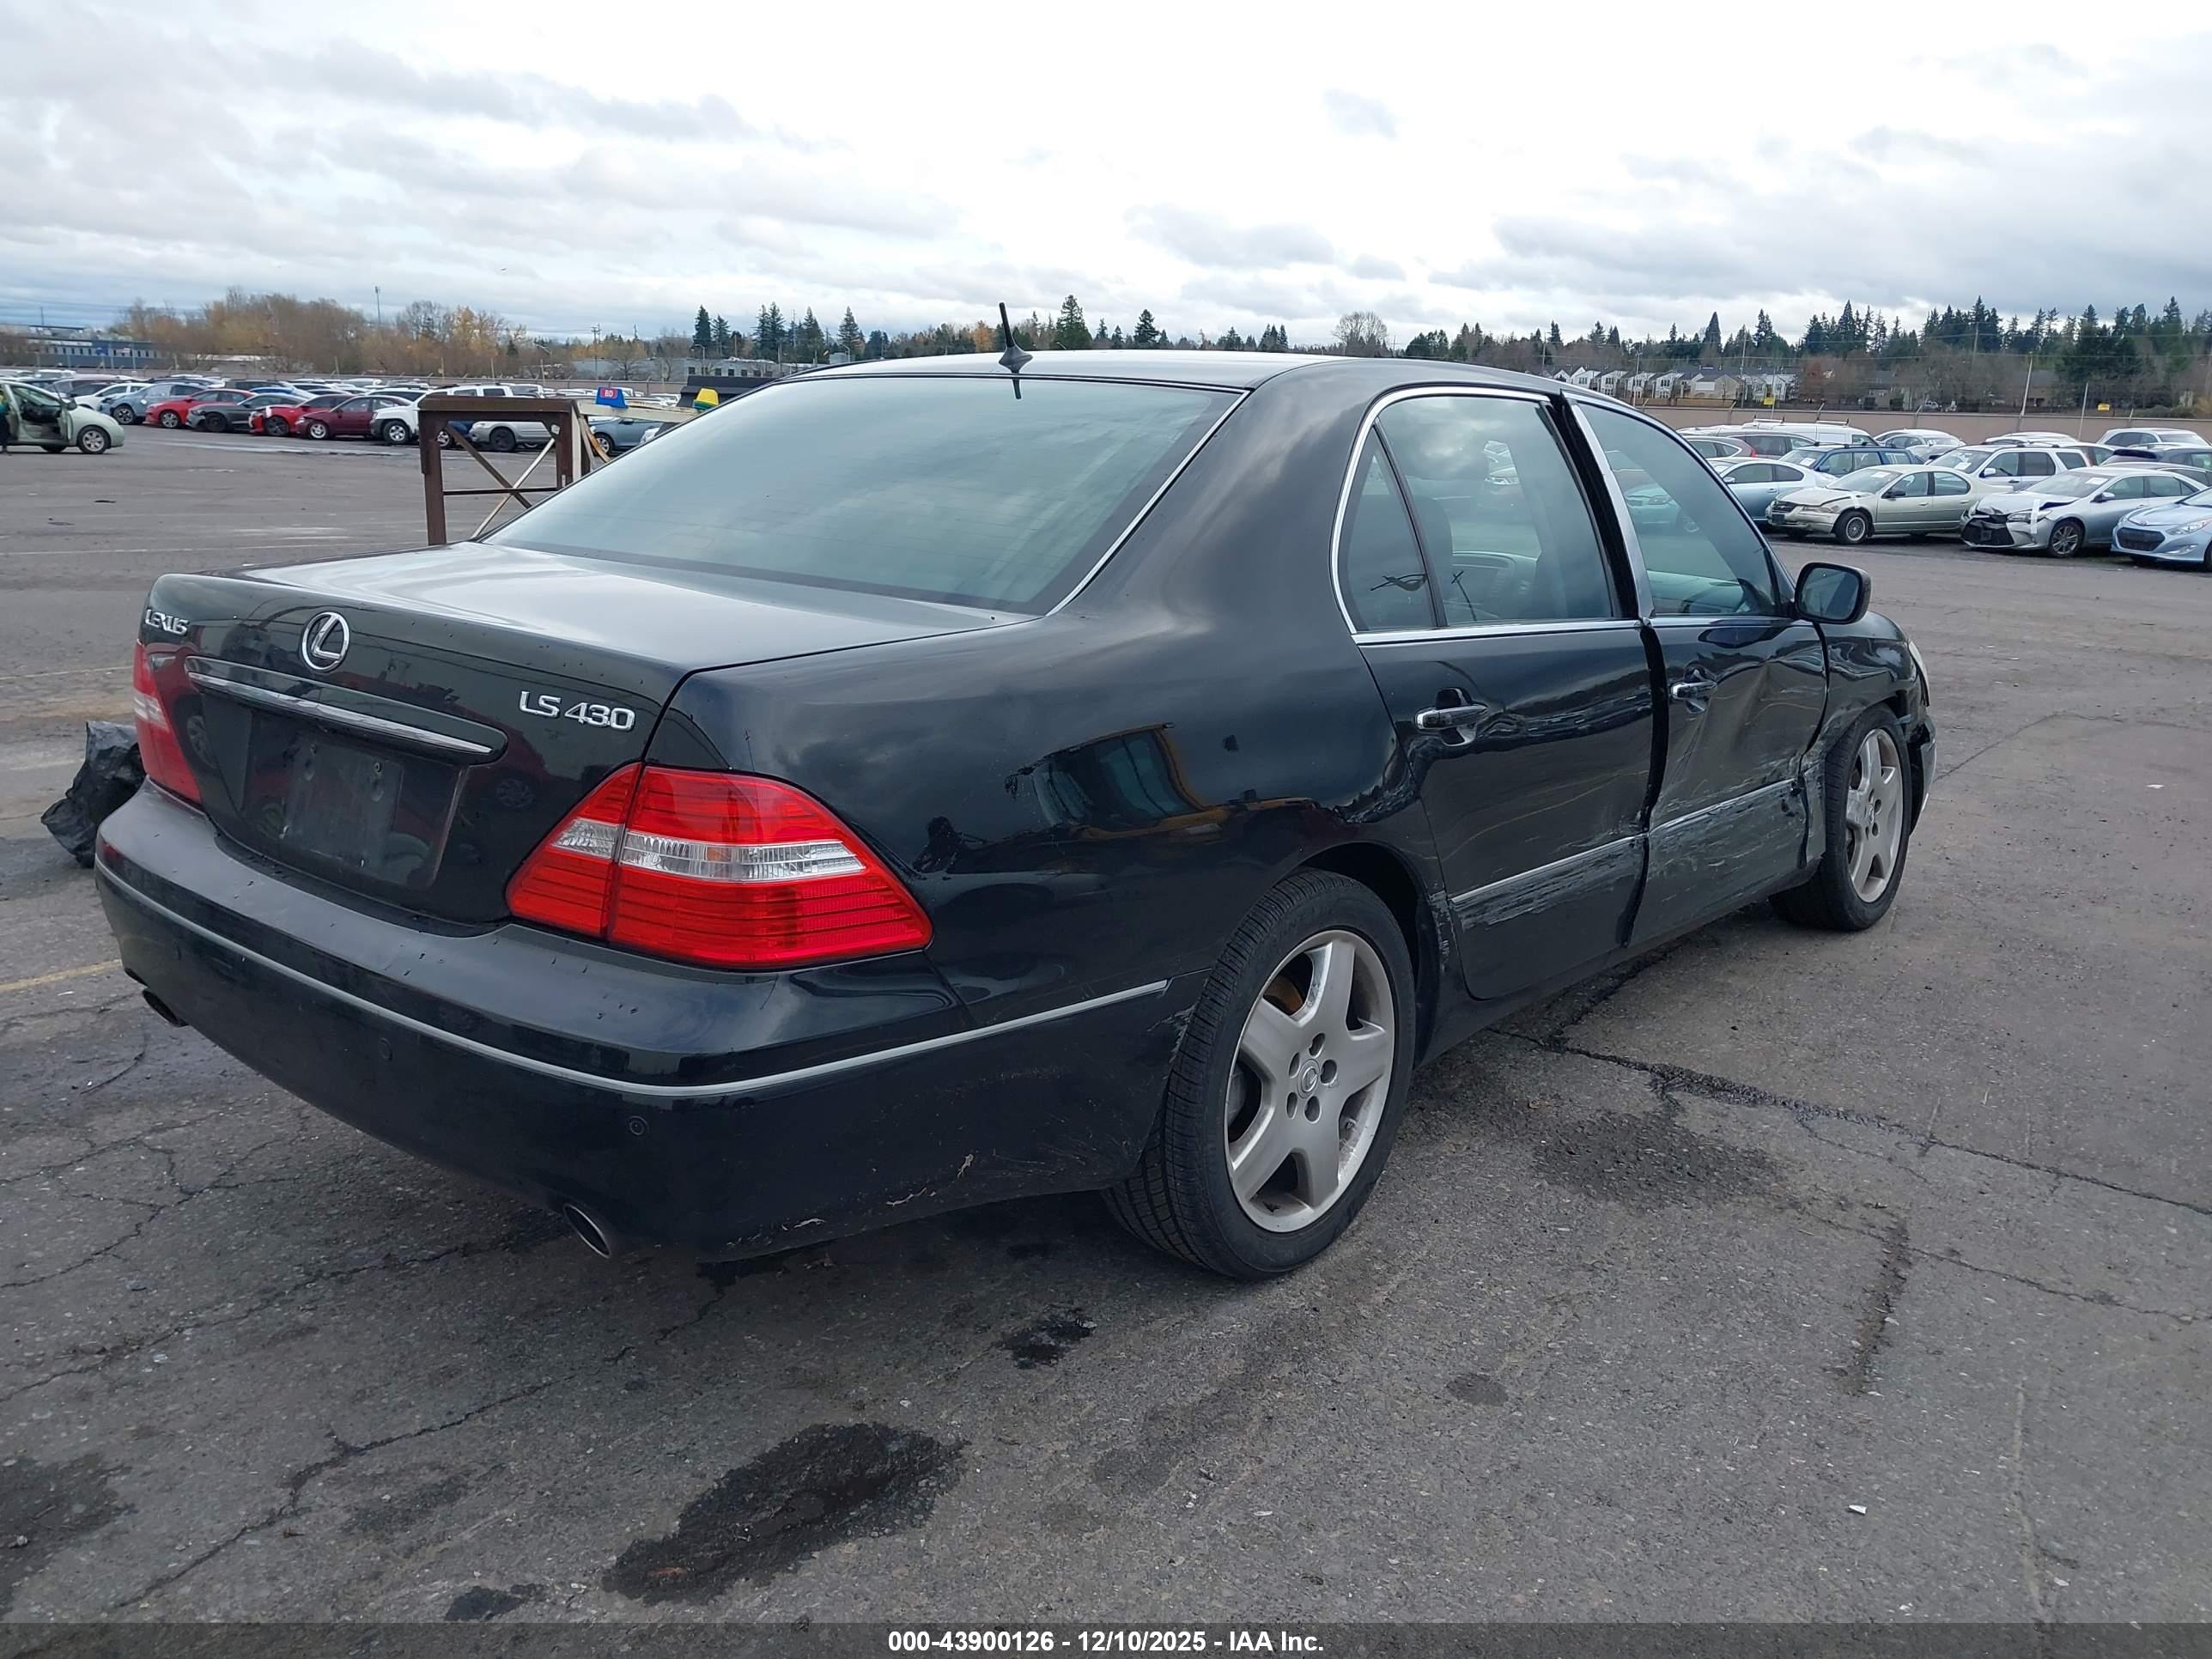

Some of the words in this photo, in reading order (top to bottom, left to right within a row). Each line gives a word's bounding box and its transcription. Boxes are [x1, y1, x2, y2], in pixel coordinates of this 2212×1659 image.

[144, 609, 189, 635] LEXUS
[520, 690, 562, 718] LS
[564, 702, 635, 730] 430
